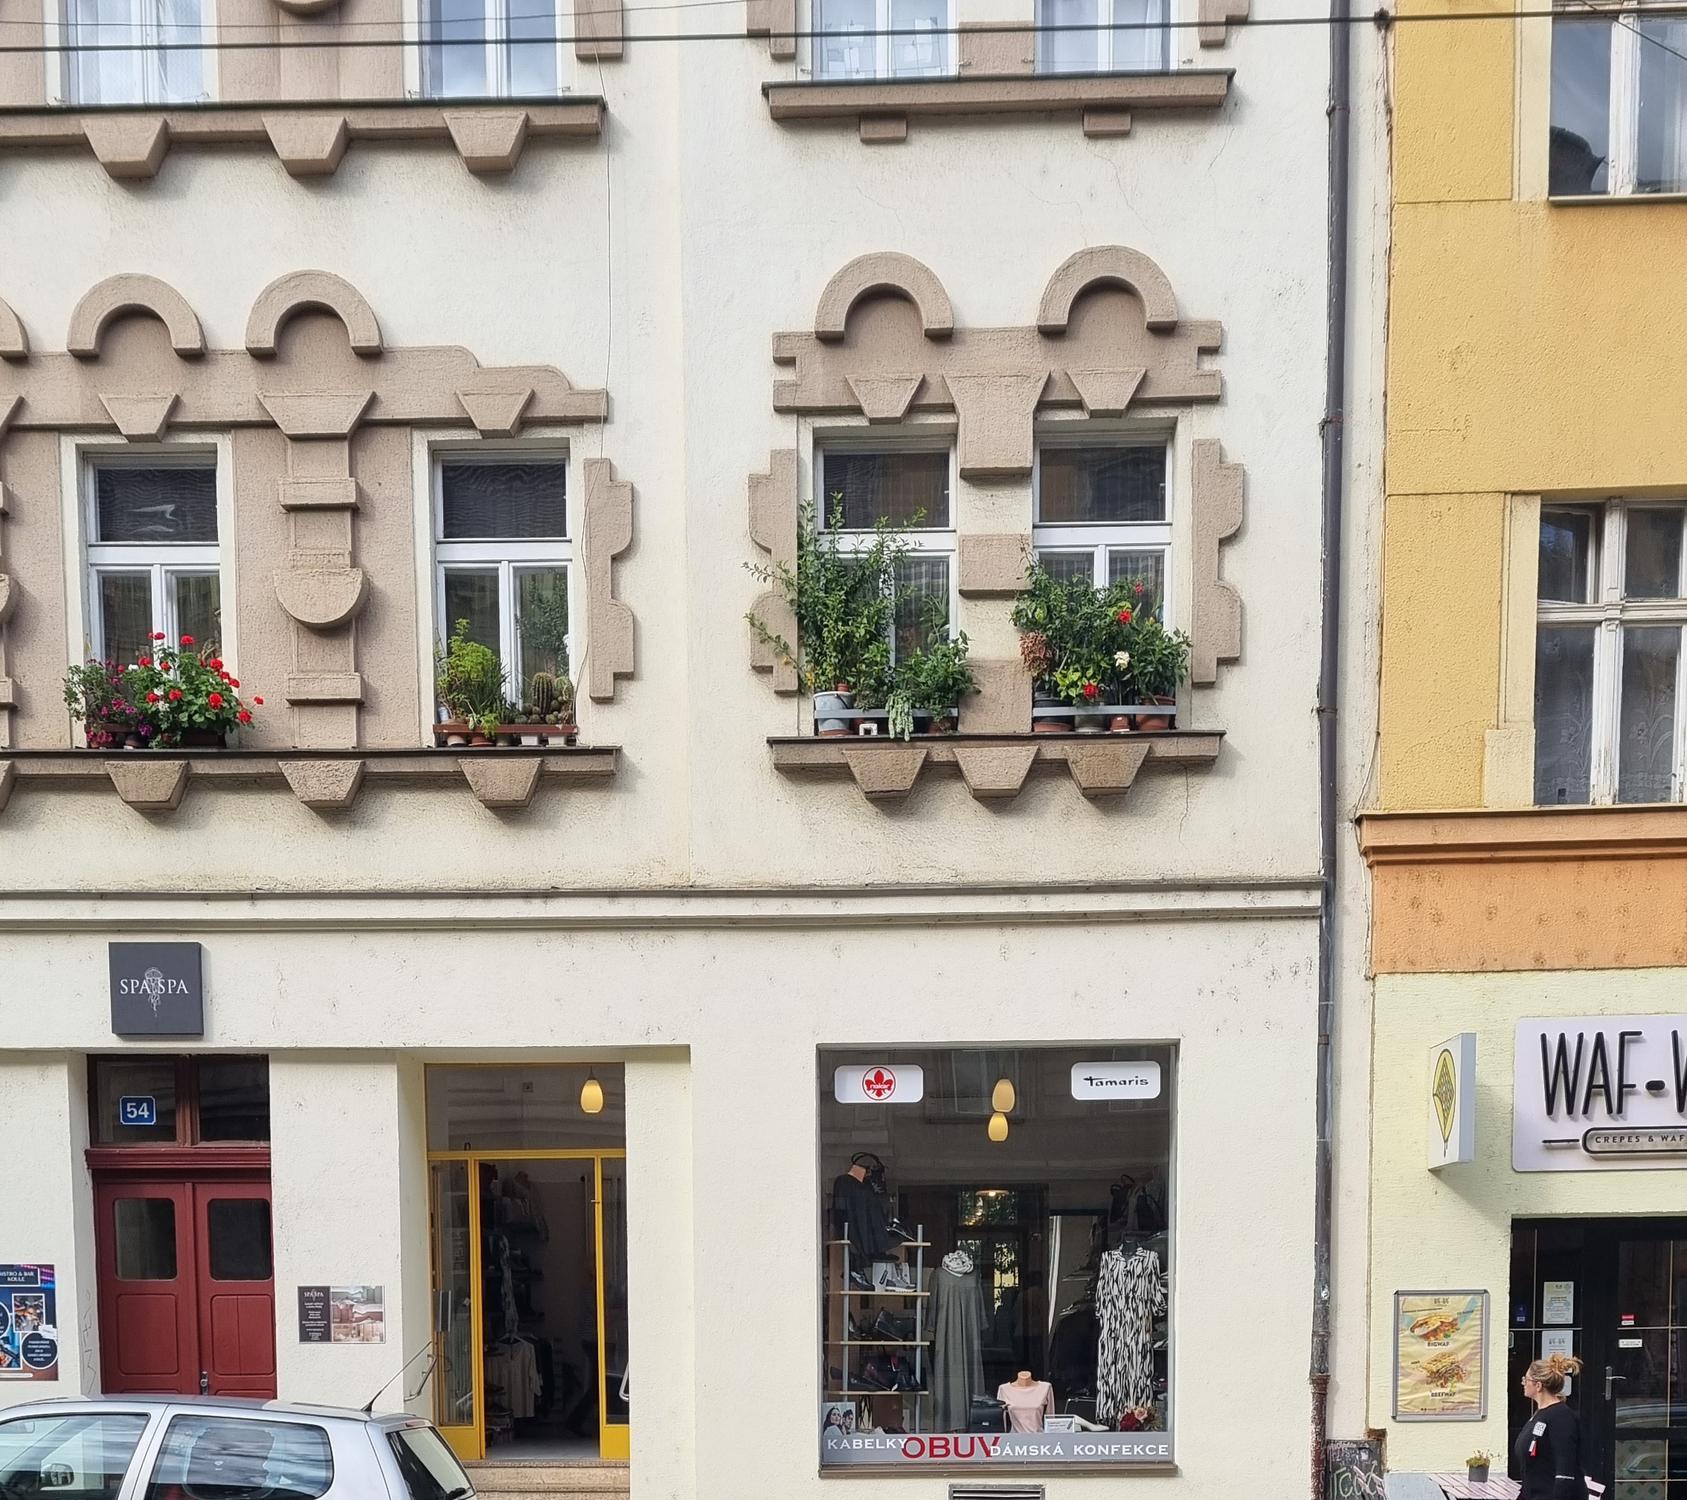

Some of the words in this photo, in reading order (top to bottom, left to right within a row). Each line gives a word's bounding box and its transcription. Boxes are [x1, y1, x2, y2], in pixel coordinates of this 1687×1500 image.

[119, 978, 152, 994] SPA
[157, 979, 189, 994] SPA
[126, 1102, 150, 1119] 54
[1595, 1135, 1641, 1144] CREPES
[1647, 1135, 1654, 1143] &
[827, 1438, 908, 1450] KABELKY
[901, 1436, 1001, 1459] OBUV
[990, 1442, 1065, 1457] DÁMSKÁ
[1073, 1444, 1169, 1456] KONFEKCE
